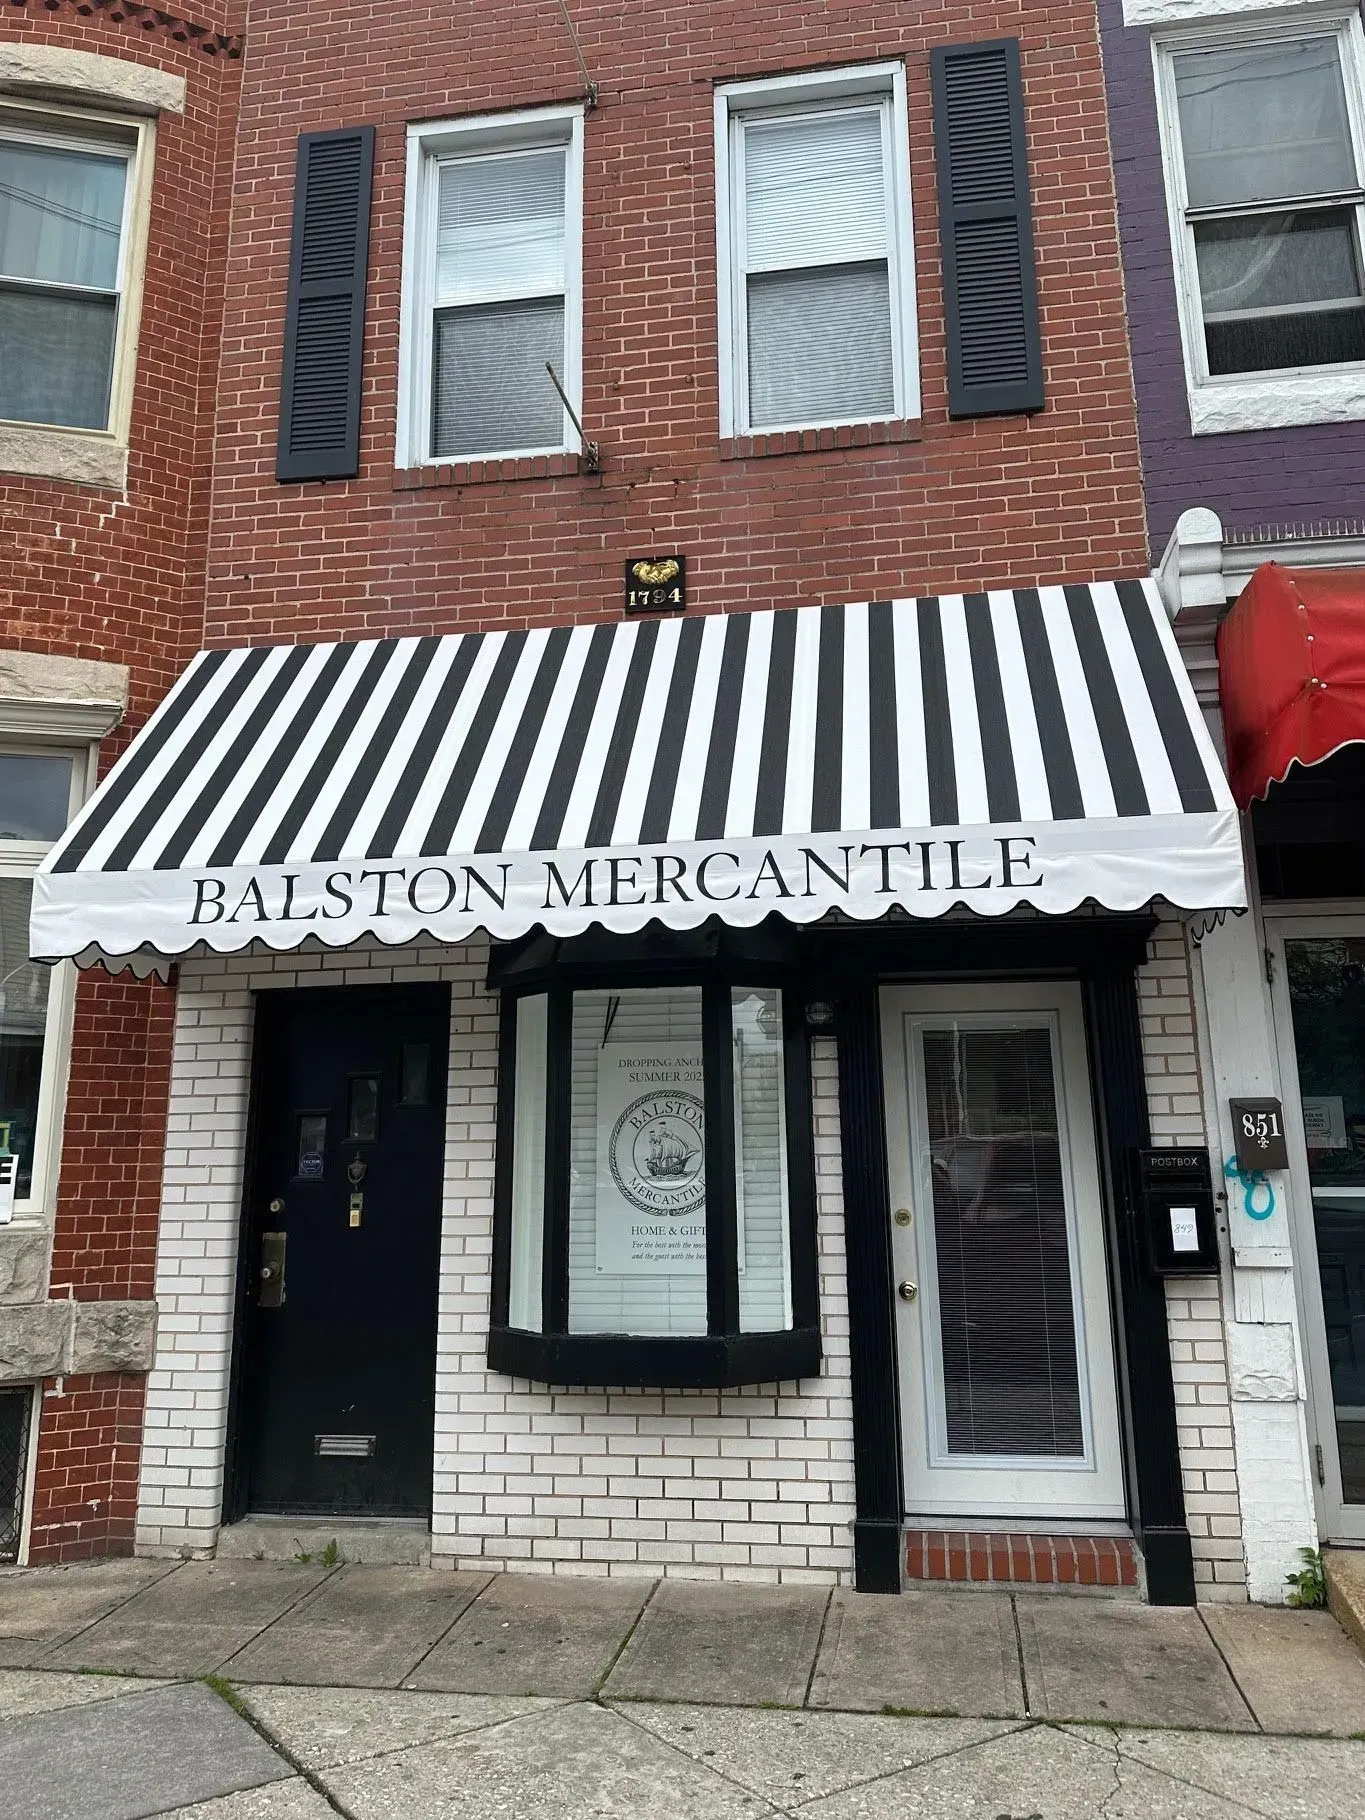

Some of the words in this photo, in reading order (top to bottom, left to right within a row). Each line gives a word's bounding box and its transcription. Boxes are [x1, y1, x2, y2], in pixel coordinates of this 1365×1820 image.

[629, 587, 683, 606] 1794
[186, 863, 514, 926] BALSTON
[540, 836, 1044, 911] MERCANTILE
[618, 1058, 672, 1068] DROPPING
[629, 1071, 681, 1082] SUMMER
[684, 1071, 704, 1082] 202
[629, 1100, 705, 1130] BALSTON
[1242, 1112, 1282, 1137] 851
[1151, 1157, 1198, 1167] POSTBOX
[631, 1225, 666, 1236] HOME
[668, 1226, 677, 1236] &
[1173, 1223, 1194, 1234] 849
[632, 1240, 643, 1249] For
[644, 1240, 653, 1249] the
[667, 1240, 681, 1249] with
[682, 1240, 692, 1249] the
[631, 1252, 644, 1260] and
[644, 1252, 653, 1260] the
[653, 1253, 670, 1262] guest
[670, 1252, 684, 1260] with
[685, 1252, 694, 1260] the
[695, 1252, 706, 1260] bes
